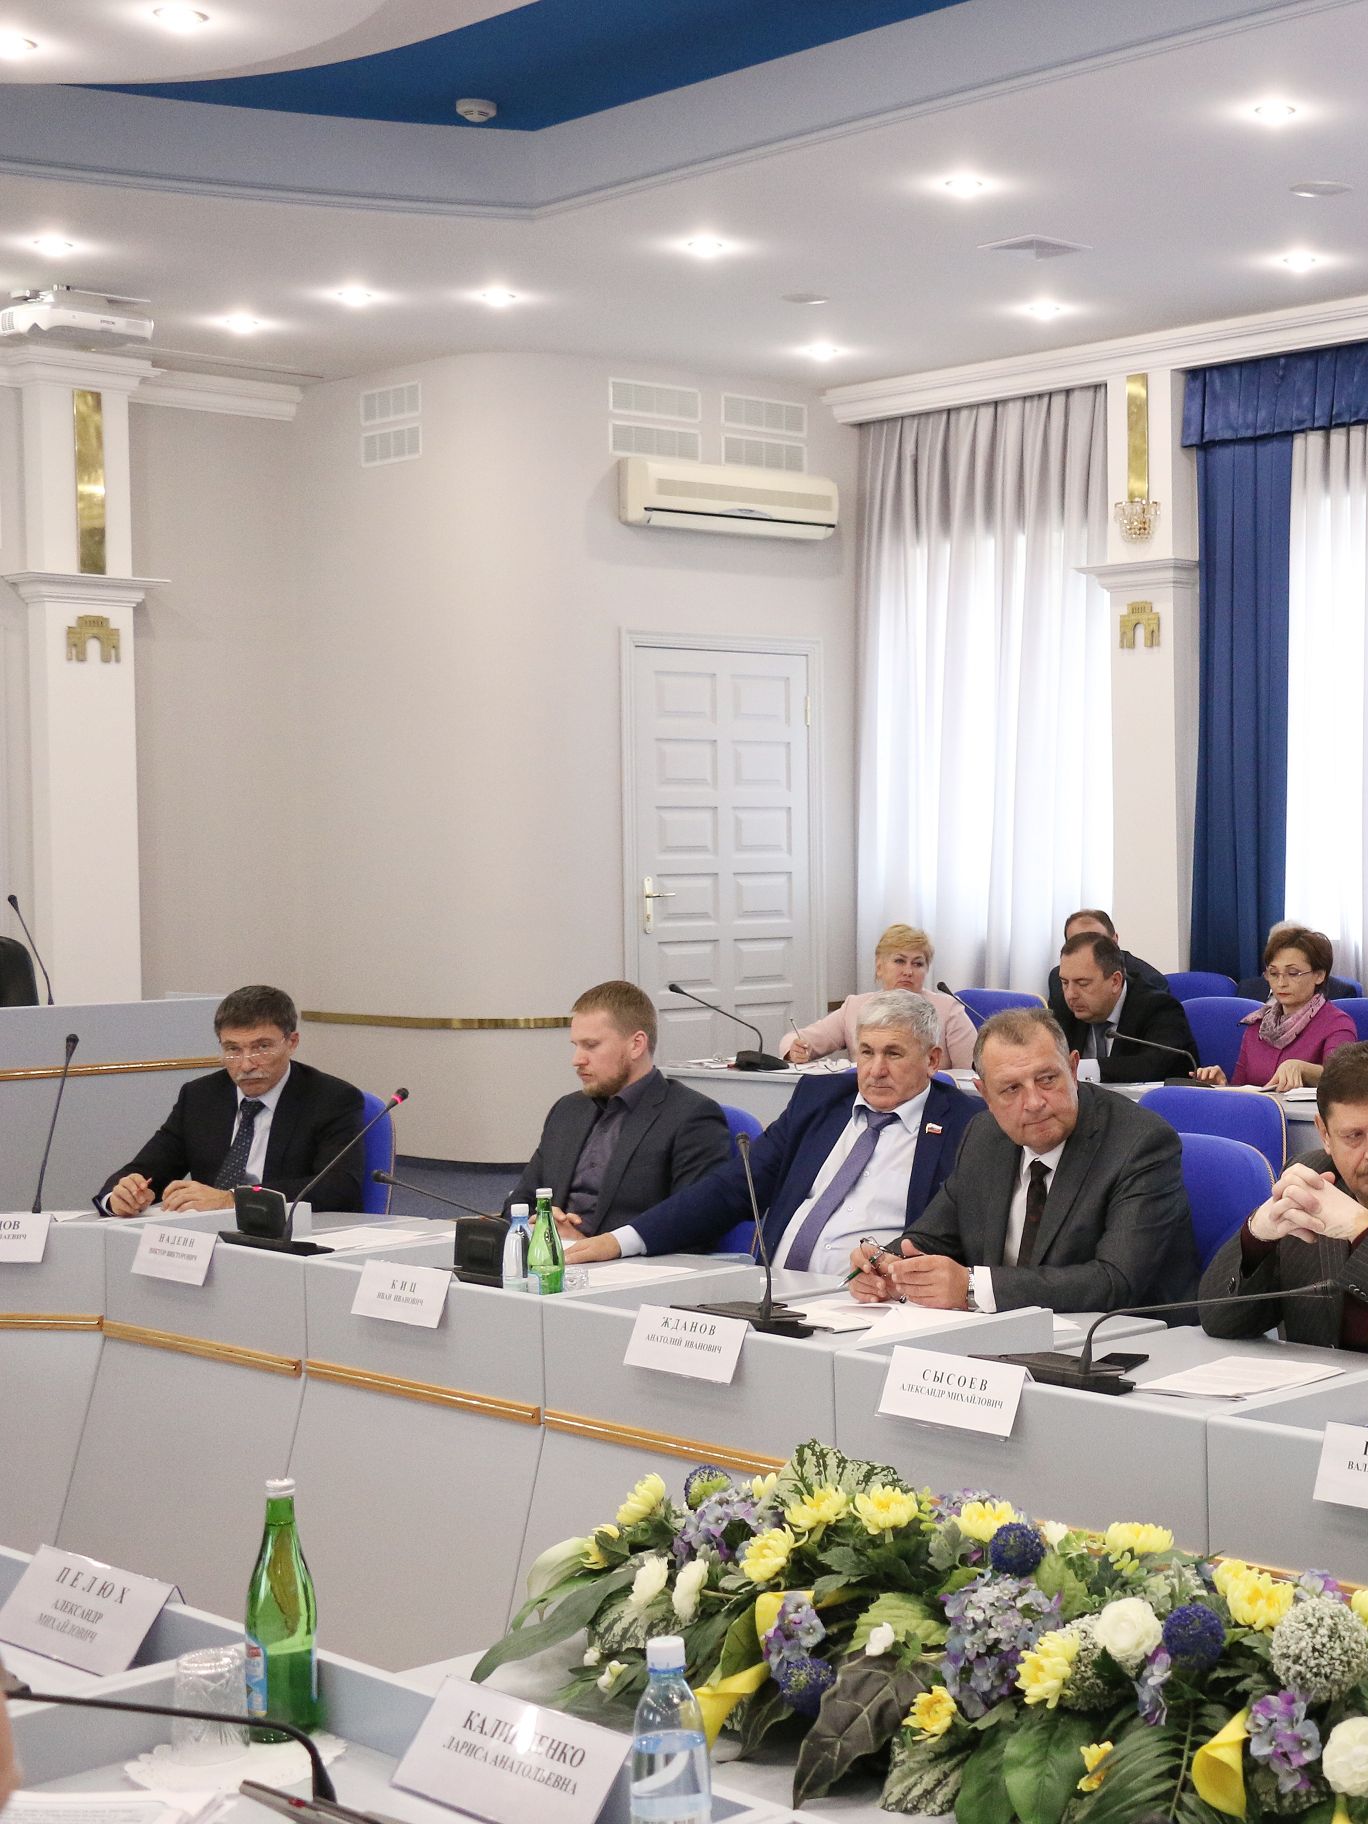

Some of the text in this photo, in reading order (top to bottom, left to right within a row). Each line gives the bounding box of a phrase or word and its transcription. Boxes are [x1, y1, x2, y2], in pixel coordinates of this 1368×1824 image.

[660, 1316, 717, 1336] ЖДАНОВ
[646, 1334, 722, 1354] АНАТОЛИЙ ИВАНОВИЧ
[922, 1368, 989, 1392] СЫСОЕВ
[900, 1383, 1004, 1409] АЛЕКСАНДР МИХАЙЛОВИЧ
[56, 1566, 131, 1605] ПЕЛЮХ
[53, 1599, 104, 1625] АЛЕКСАНДР
[36, 1613, 98, 1643] МИХАЙЛОВИЧ
[442, 1735, 579, 1796] ЛАРИСА АНАТОЛЬЕВНА
